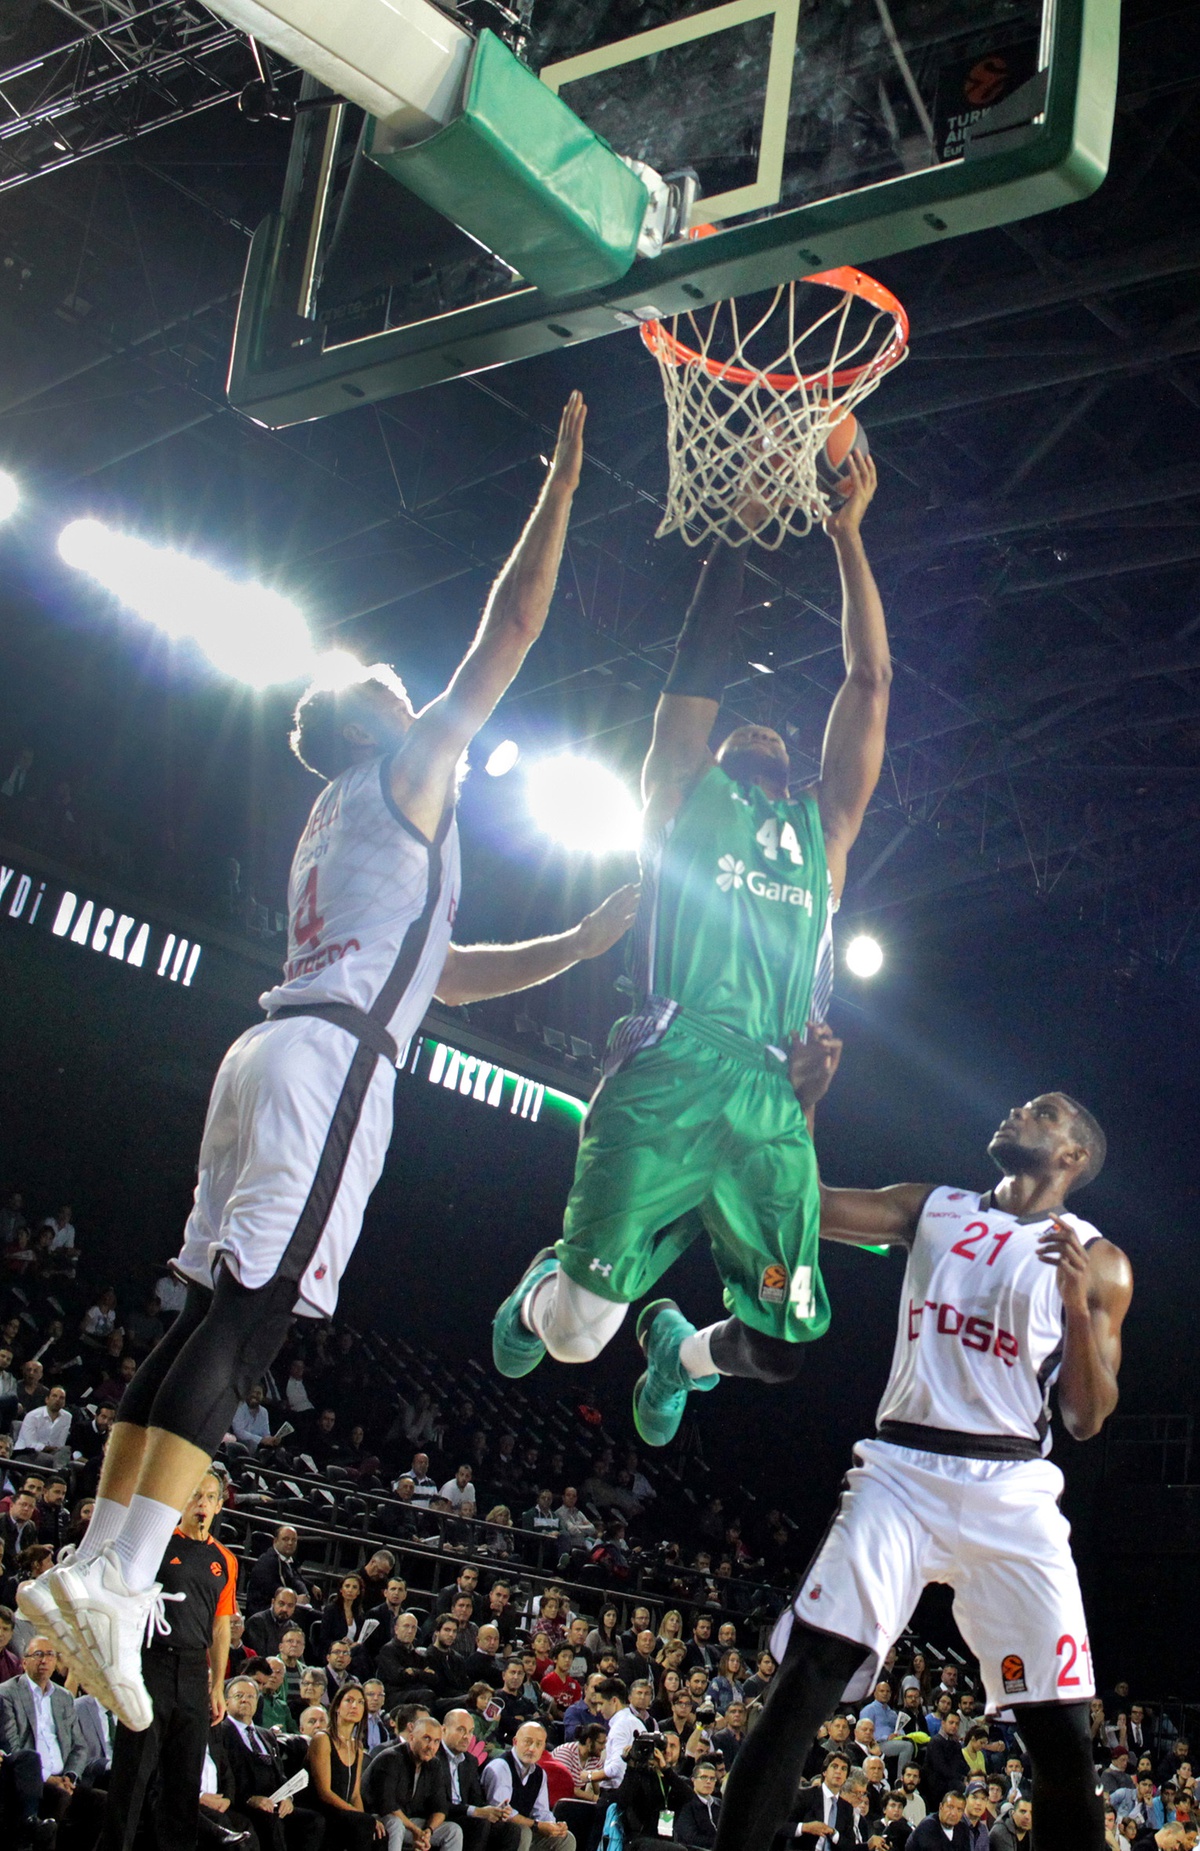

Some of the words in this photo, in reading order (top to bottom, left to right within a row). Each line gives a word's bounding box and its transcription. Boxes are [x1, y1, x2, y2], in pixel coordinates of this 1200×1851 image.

[756, 817, 804, 866] 44
[294, 865, 324, 950] 4
[950, 1221, 1013, 1266] 21
